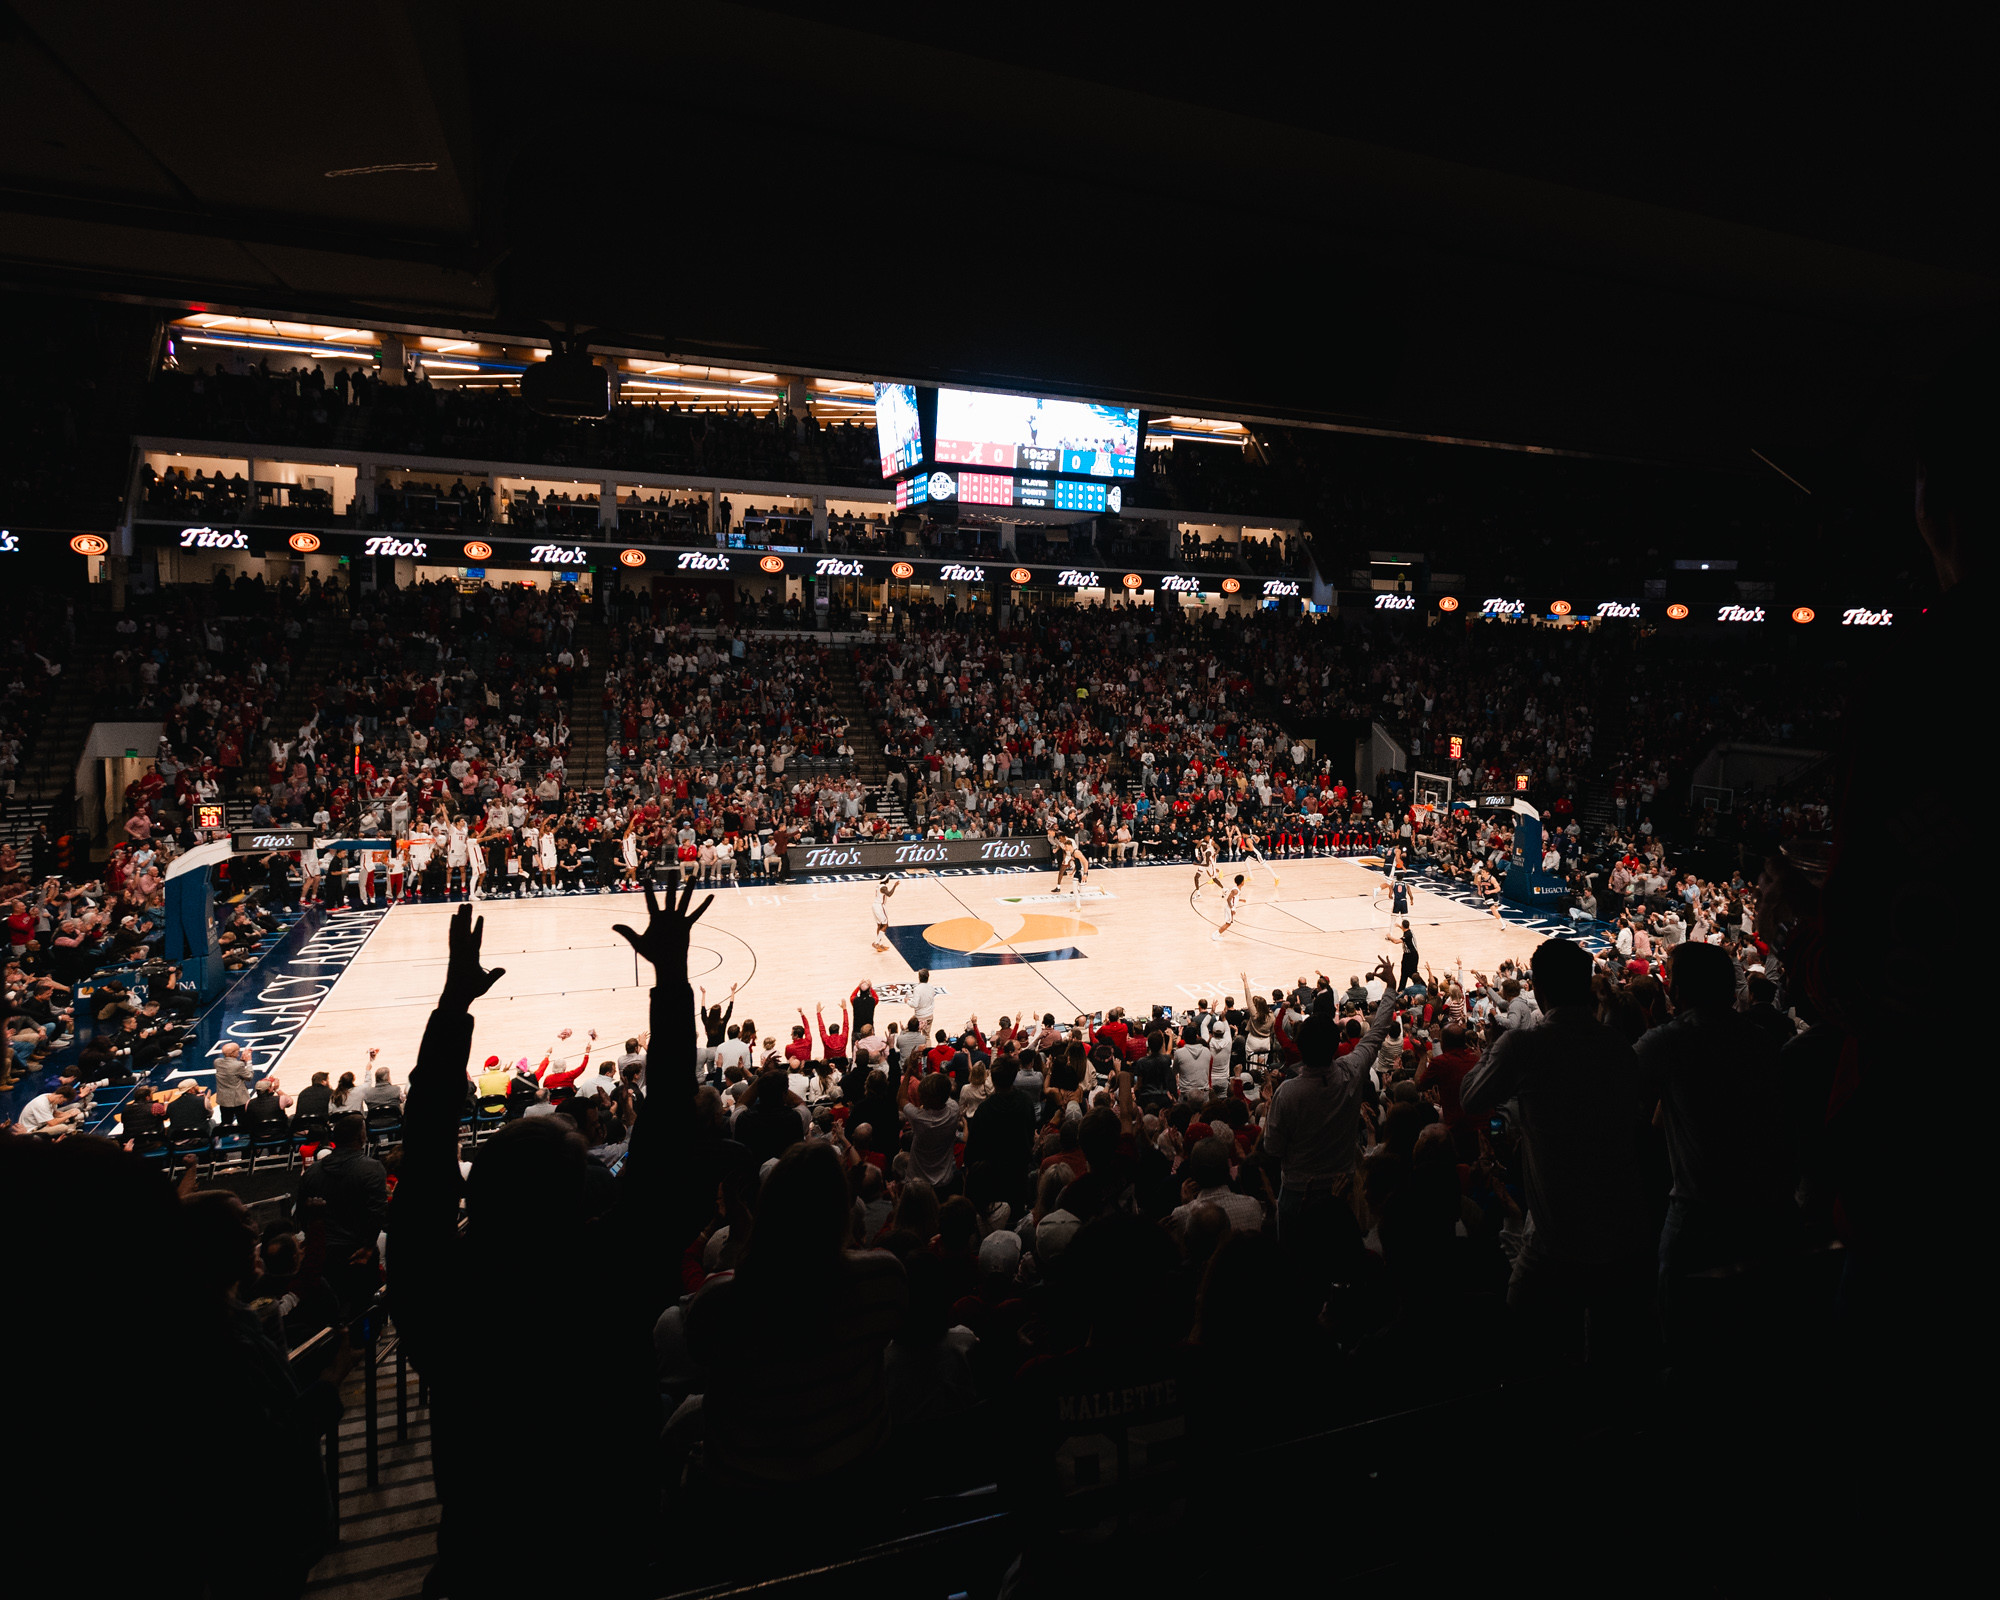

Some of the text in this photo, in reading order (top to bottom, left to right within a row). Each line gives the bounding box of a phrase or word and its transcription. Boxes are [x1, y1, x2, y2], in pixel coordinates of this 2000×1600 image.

[994, 449, 1003, 463] 0
[1022, 448, 1055, 461] 19:25
[1030, 461, 1049, 470] 1ST
[1072, 456, 1080, 469] 0
[1022, 479, 1048, 487] PLAYER
[1022, 498, 1045, 506] FOULS
[1450, 745, 1461, 758] 30
[199, 806, 221, 815] 19:24
[201, 816, 218, 826] 30
[288, 907, 388, 965] ARENA
[1058, 1378, 1176, 1422] MALLETTE
